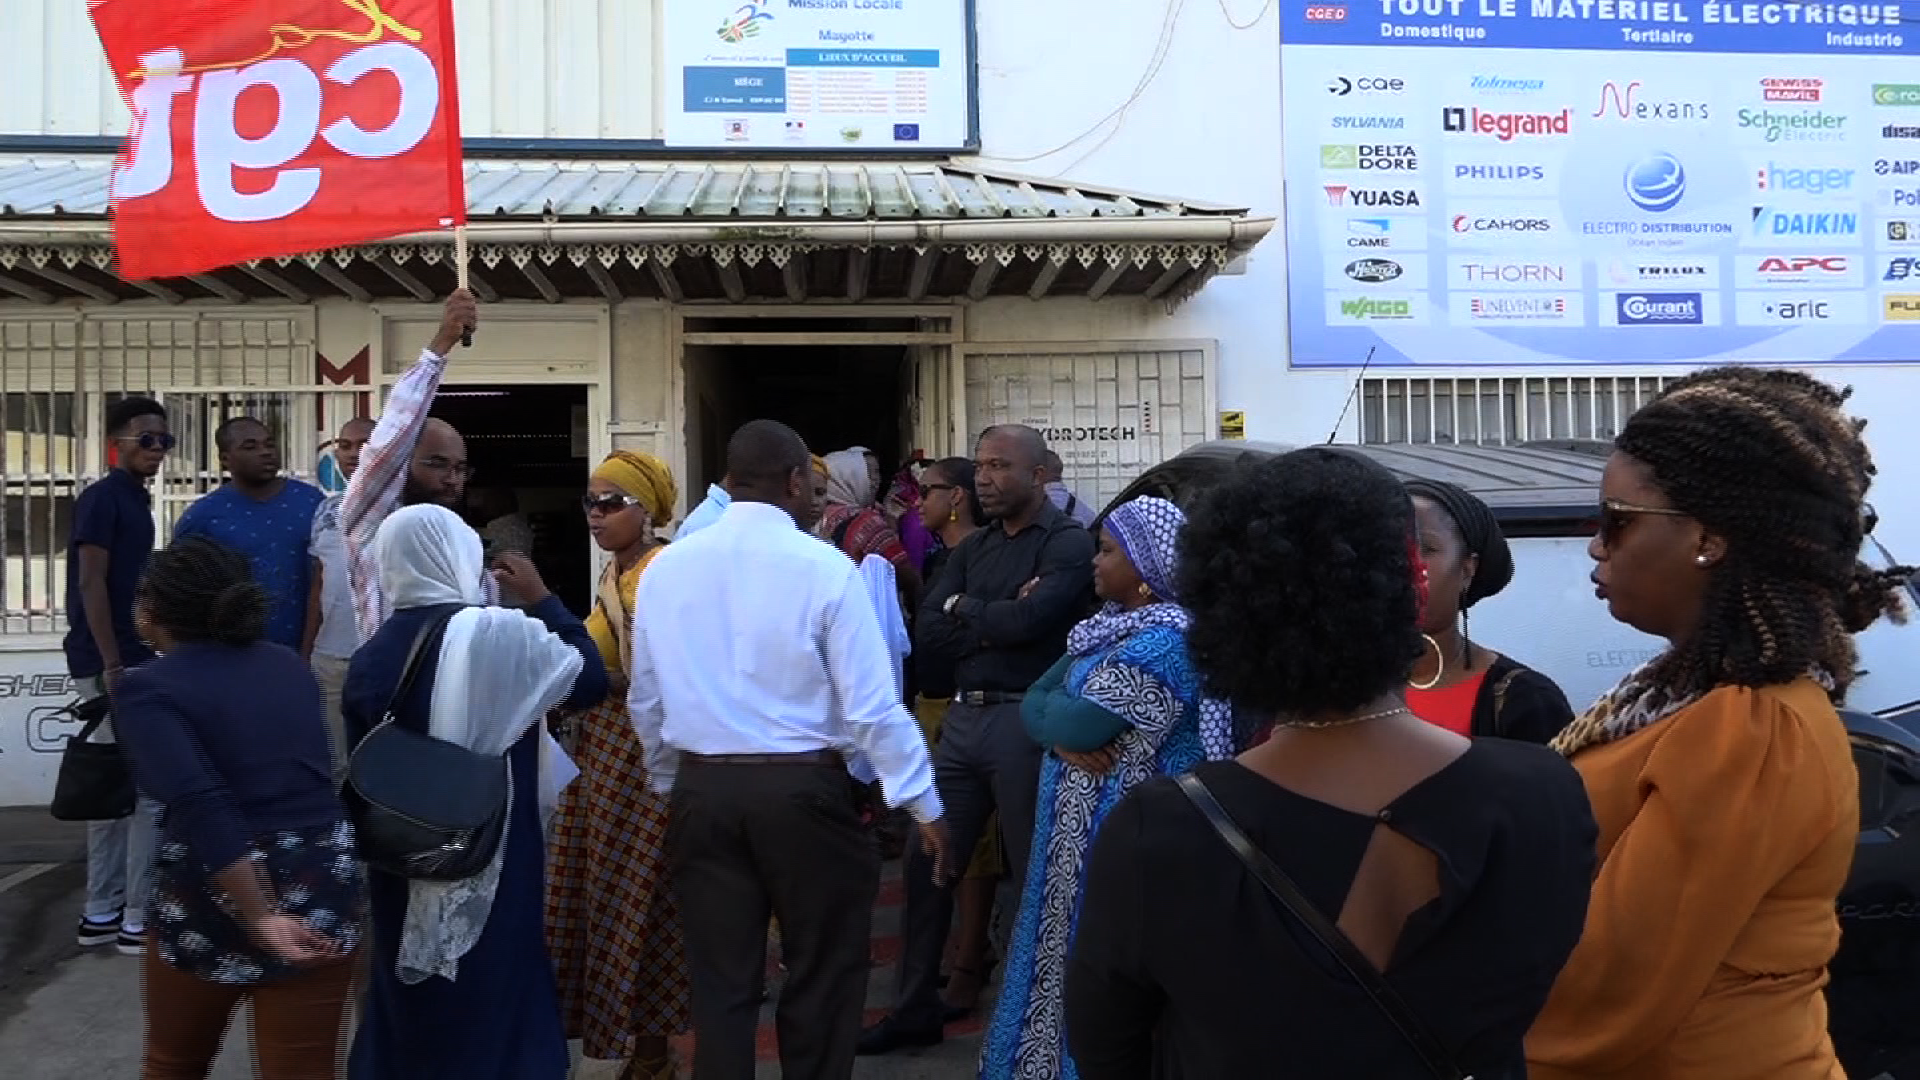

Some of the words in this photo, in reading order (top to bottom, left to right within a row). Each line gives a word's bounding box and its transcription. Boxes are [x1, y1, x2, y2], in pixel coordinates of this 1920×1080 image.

[789, 0, 848, 9] Mission
[854, 0, 904, 10] Locale
[1380, 0, 1465, 16] TOUT
[1479, 0, 1517, 17] LE
[1702, 1, 1901, 25] ÉLECTRIQUE
[1306, 7, 1345, 20] CGED
[818, 29, 875, 43] Mayotte
[1380, 22, 1486, 41] Domestique
[1621, 27, 1694, 44] Tertiaire
[1826, 31, 1903, 47] Industrie
[1357, 77, 1405, 91] cae
[1593, 82, 1709, 119] Nexans
[1331, 115, 1405, 129] SYLVANIA
[1471, 106, 1569, 141] legrand
[1738, 108, 1847, 128] Schneider
[1783, 128, 1846, 141] Electric
[1358, 144, 1417, 157] DELTA
[1358, 157, 1418, 170] DORE
[1455, 165, 1544, 180] PHILIPS
[1769, 161, 1855, 191] hager
[1350, 190, 1420, 206] YUASA
[1473, 218, 1550, 233] CAHORS
[1582, 221, 1637, 235] ELECTRO
[1641, 222, 1732, 233] DISTRIBUTION
[1773, 213, 1856, 235] DAIKIN
[1346, 237, 1391, 249] CAME
[1638, 266, 1706, 275] TRILUX
[1757, 257, 1846, 272] APC
[1461, 263, 1564, 282] THORN
[1341, 297, 1409, 319] WAGO
[1622, 295, 1697, 320] Courant
[1778, 299, 1829, 319] aric
[1039, 426, 1135, 441] YDROTECH
